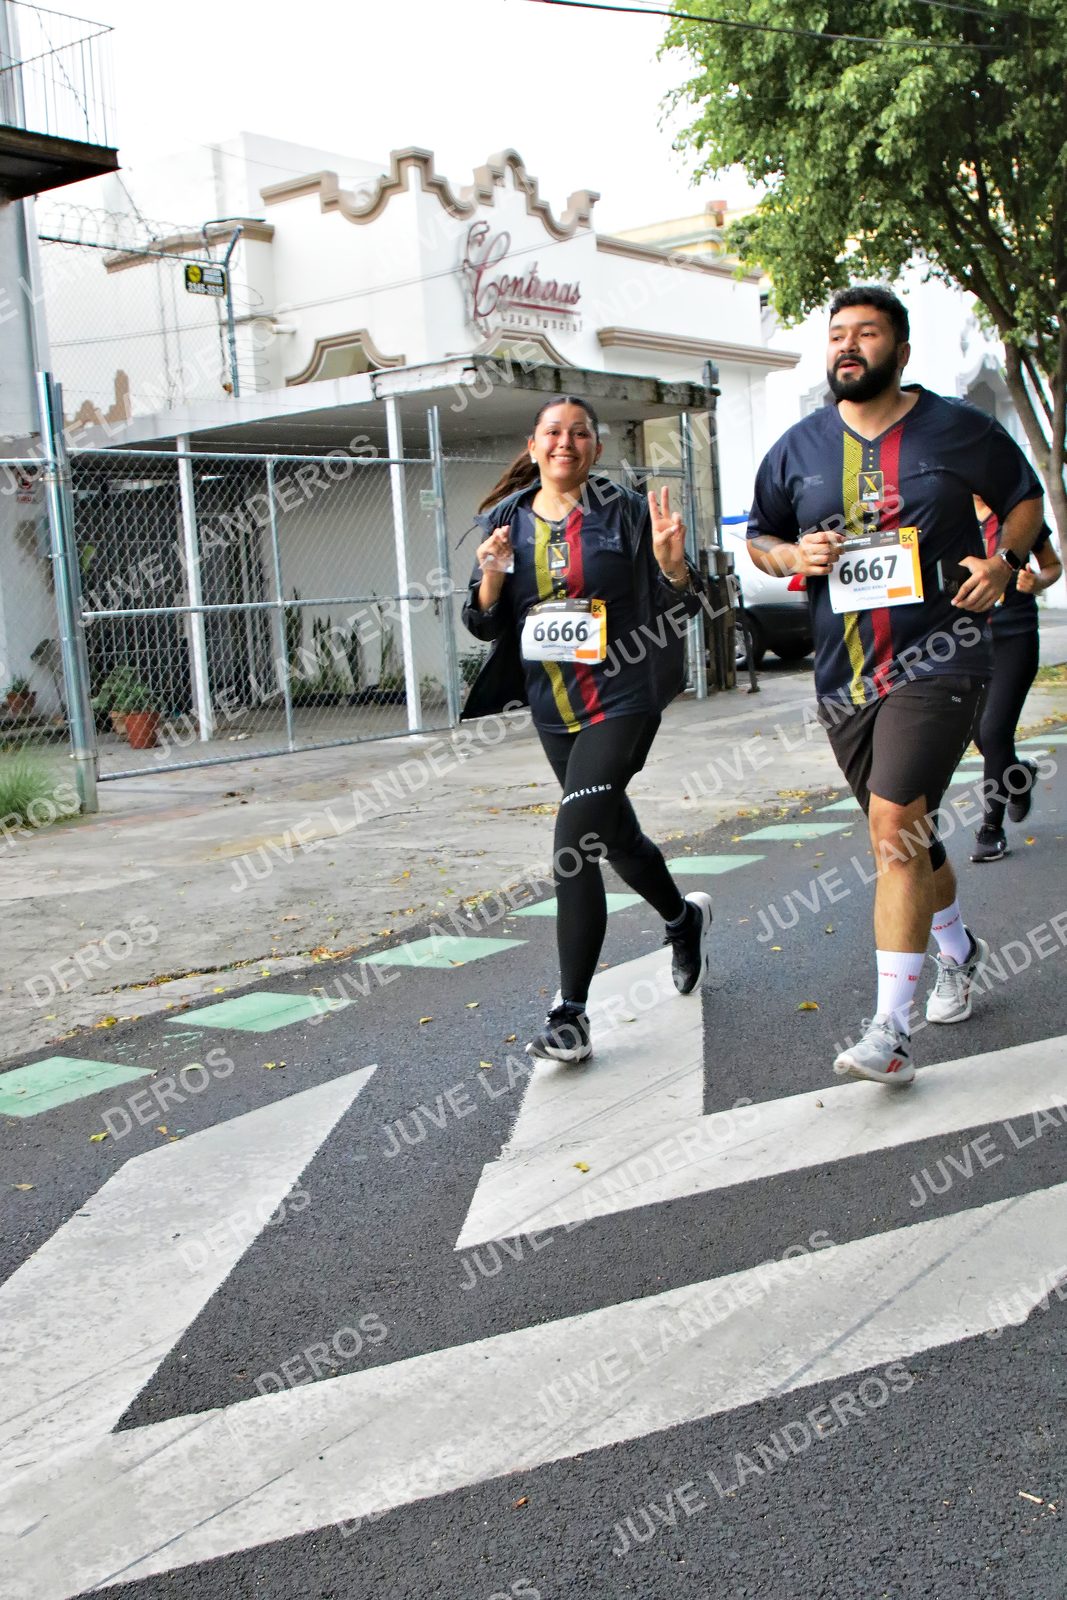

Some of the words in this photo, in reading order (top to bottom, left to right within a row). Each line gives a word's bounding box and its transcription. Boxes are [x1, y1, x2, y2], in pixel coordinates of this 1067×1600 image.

[901, 534, 913, 543] 5K
[839, 554, 898, 585] 6667
[592, 604, 602, 613] 5K
[533, 620, 588, 642] 6666
